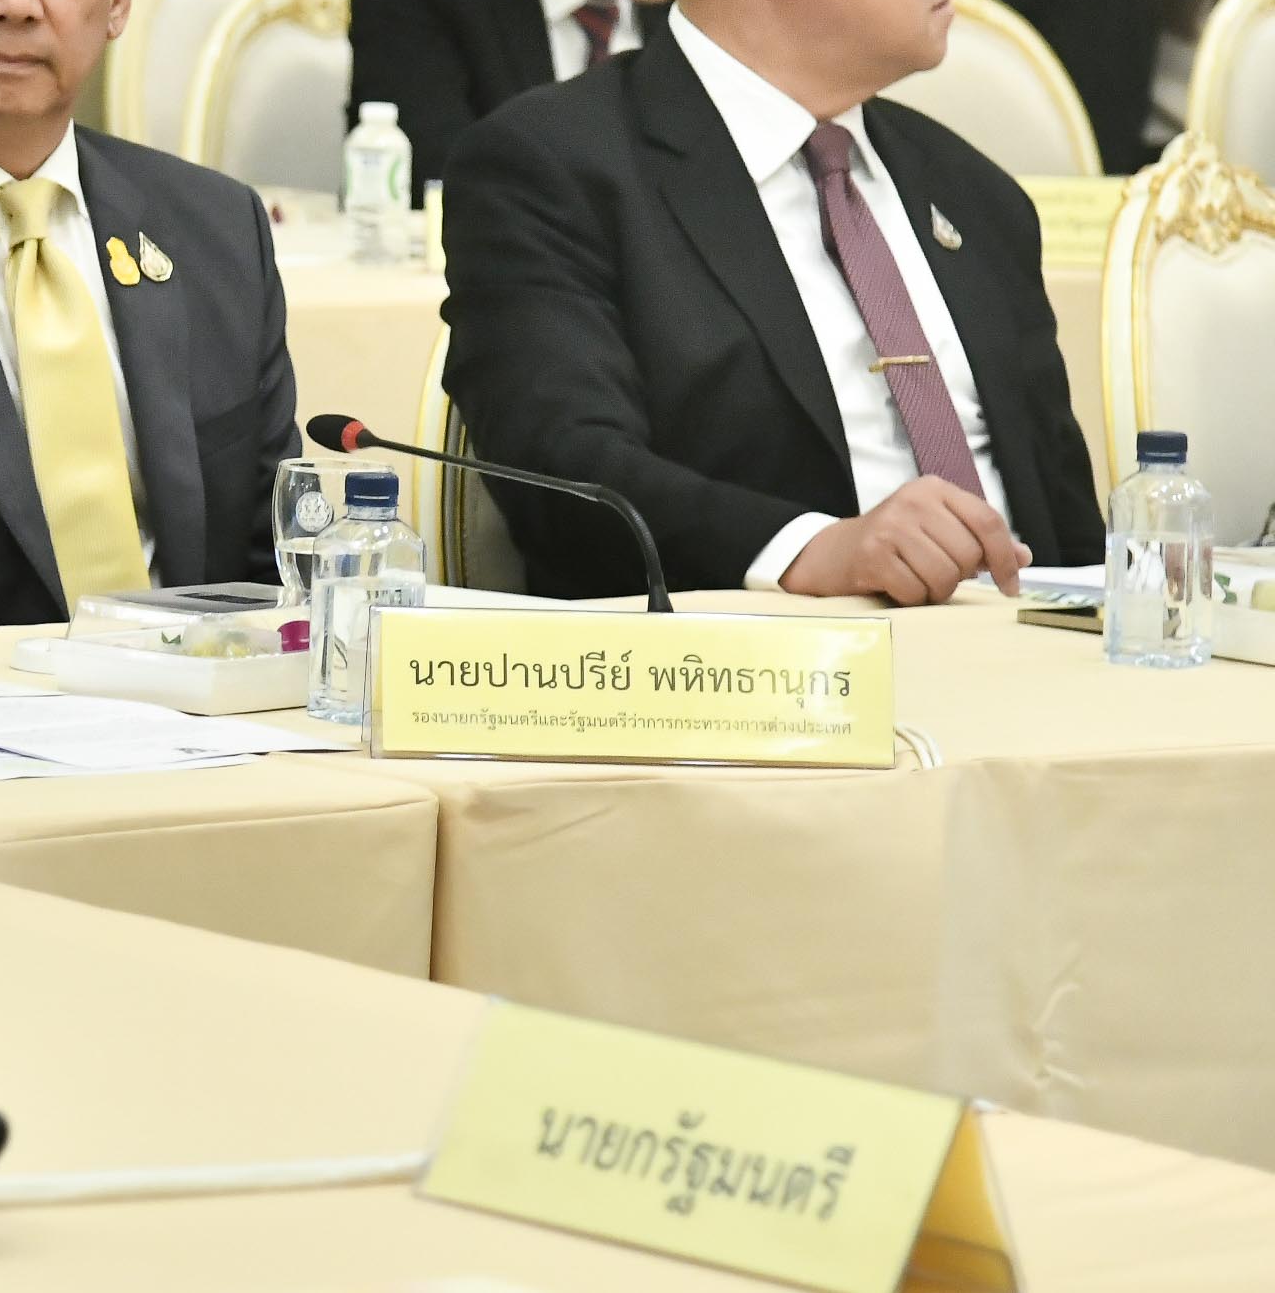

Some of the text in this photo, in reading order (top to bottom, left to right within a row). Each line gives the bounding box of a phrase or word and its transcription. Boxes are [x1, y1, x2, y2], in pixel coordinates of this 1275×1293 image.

[409, 649, 851, 709] นายปานปรีย์ พหิทธานุกร
[535, 1107, 857, 1223] นายกรัฐมนตรี
